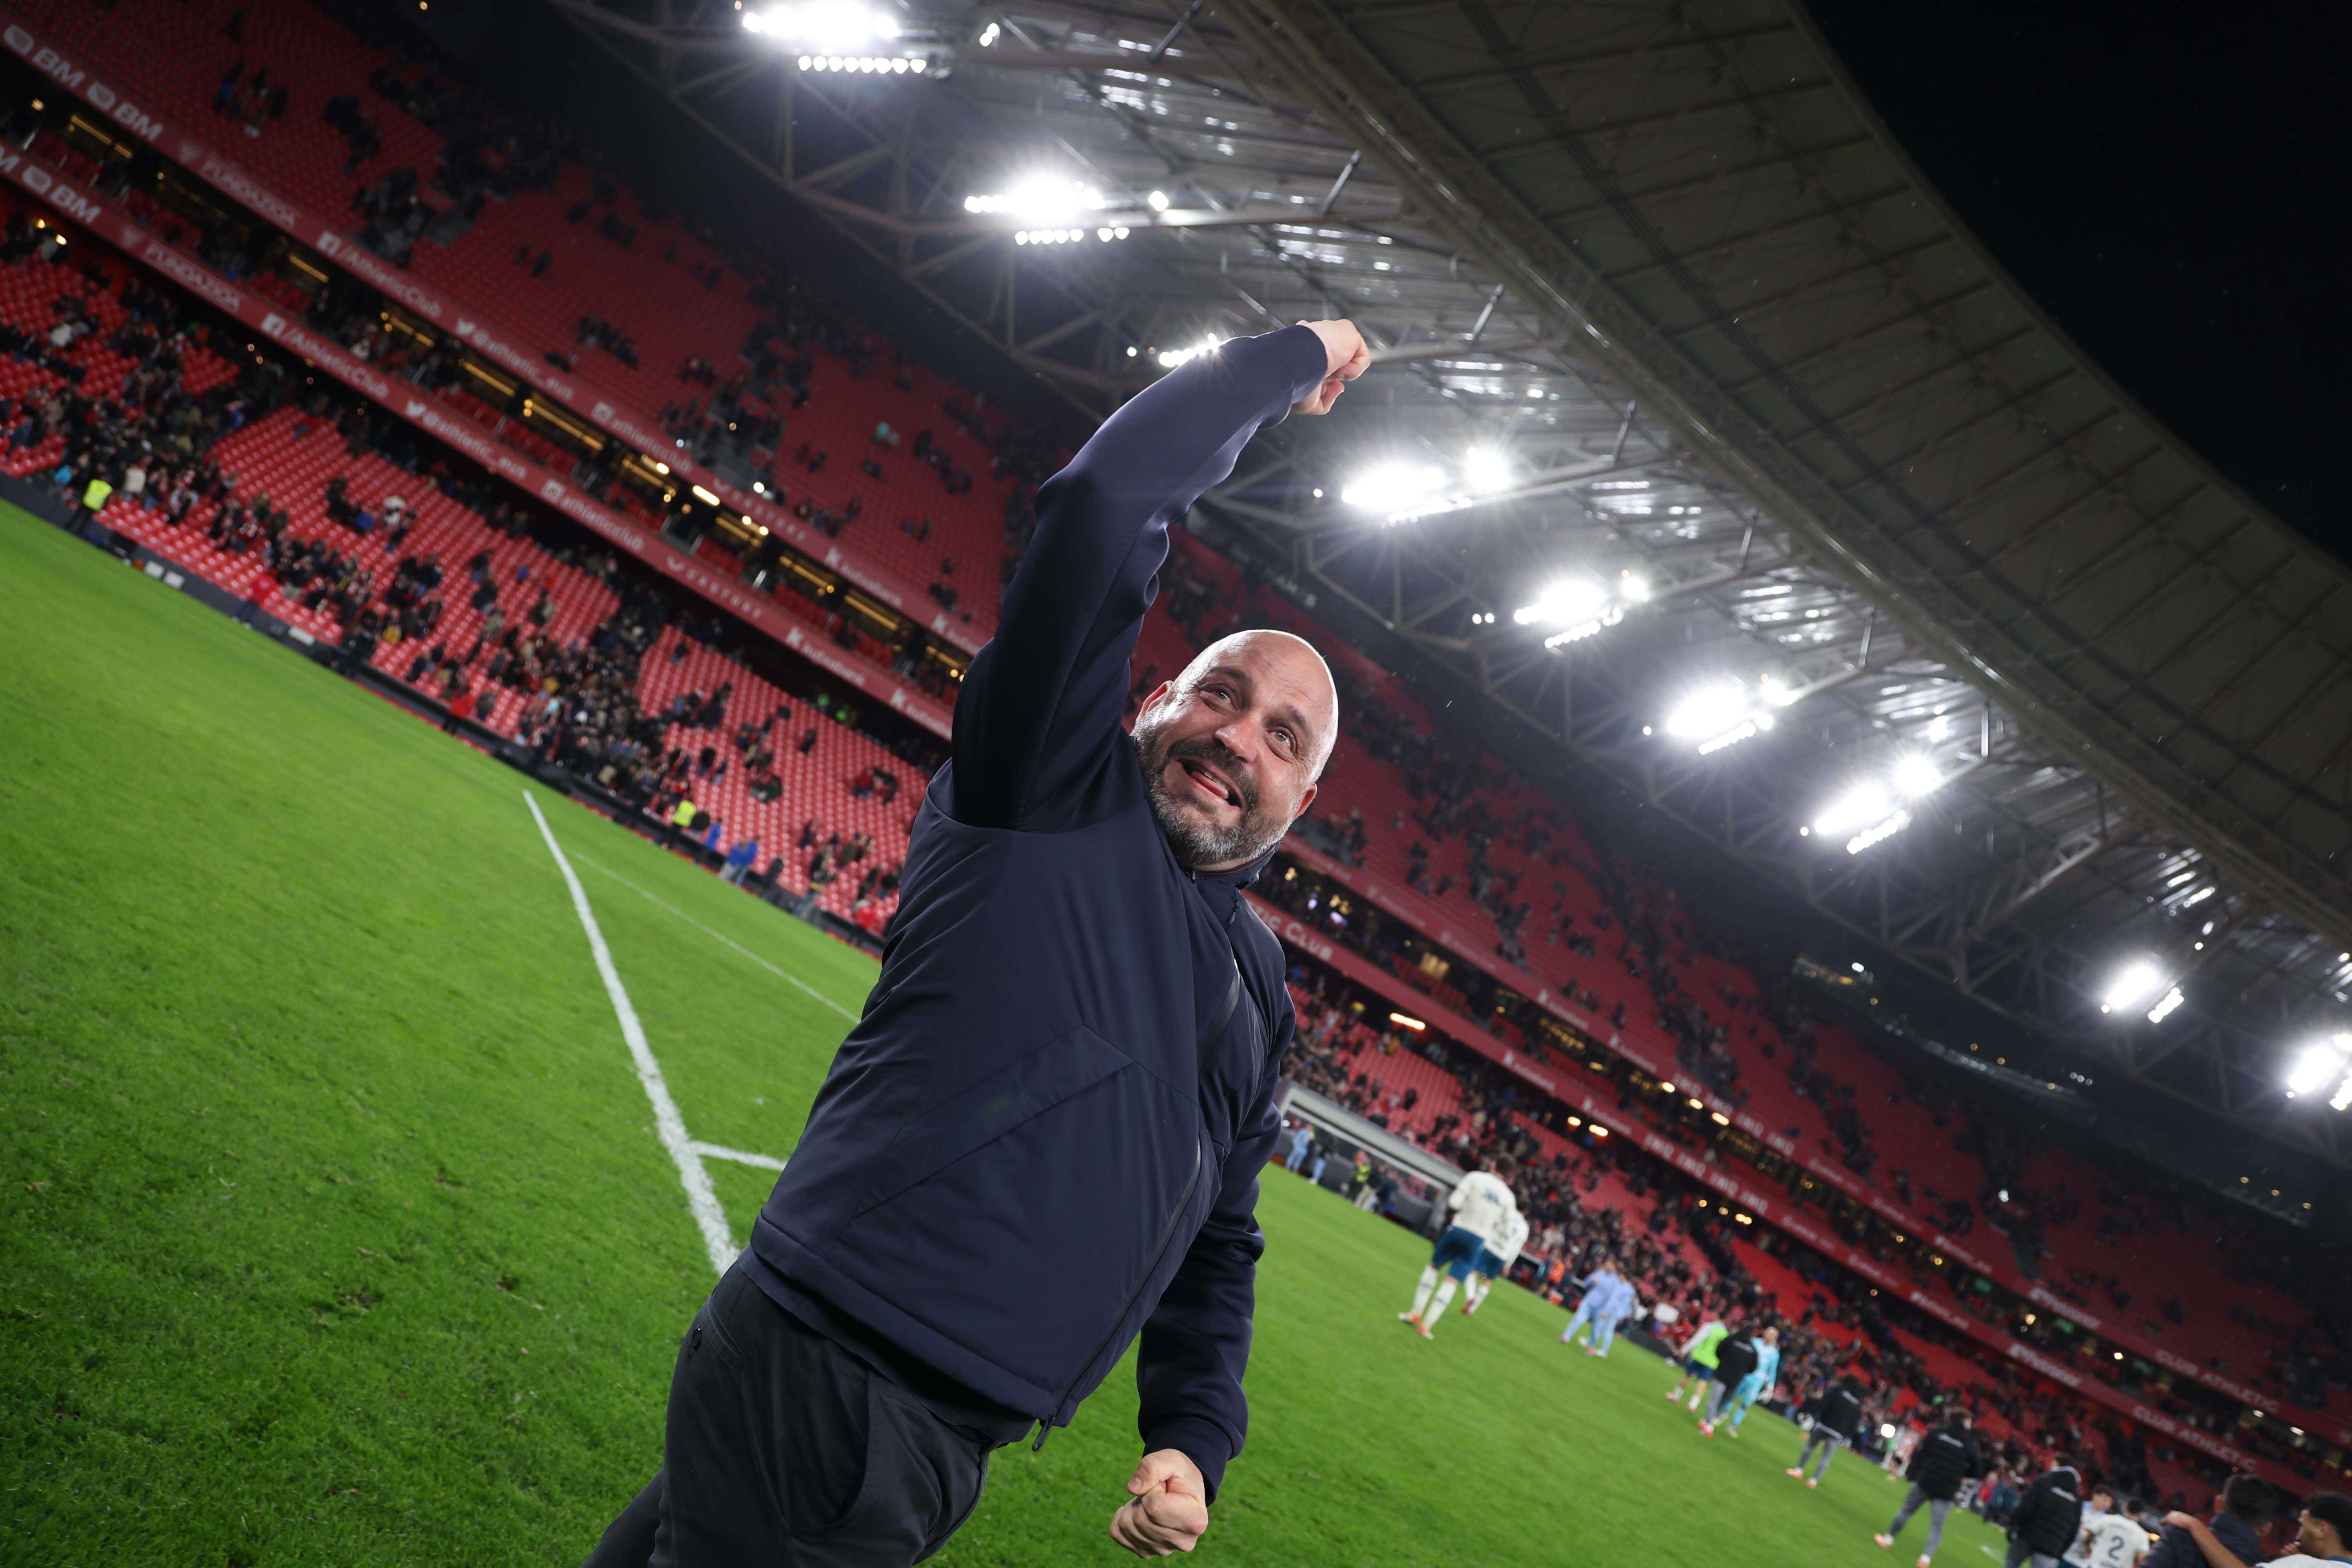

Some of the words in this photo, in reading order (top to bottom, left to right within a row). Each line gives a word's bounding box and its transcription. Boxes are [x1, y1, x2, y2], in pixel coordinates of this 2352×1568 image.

[33, 48, 85, 87] BM
[114, 103, 162, 140] BM
[50, 185, 100, 222] BM
[2108, 1535, 2124, 1560] 2
